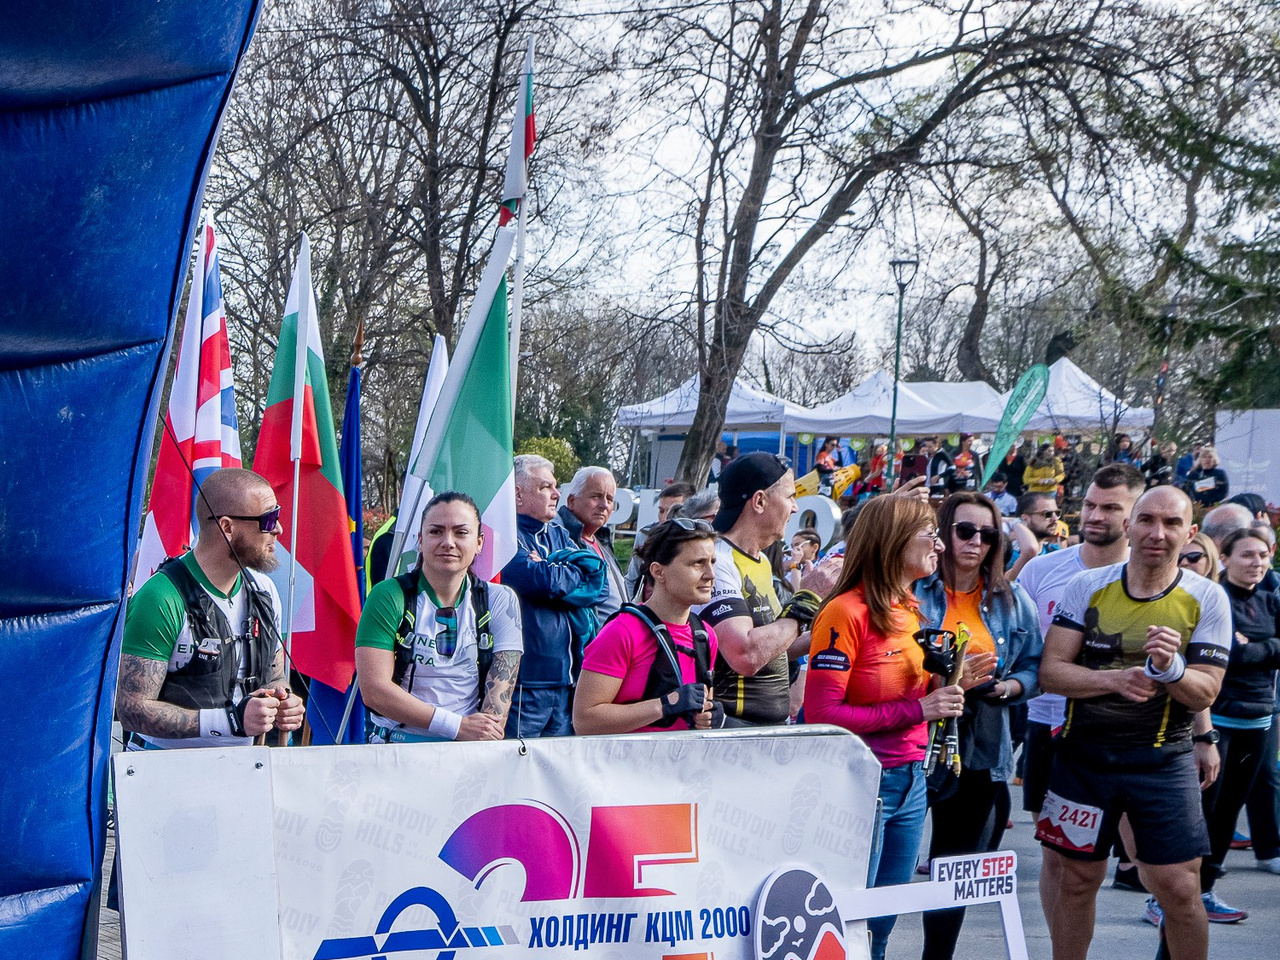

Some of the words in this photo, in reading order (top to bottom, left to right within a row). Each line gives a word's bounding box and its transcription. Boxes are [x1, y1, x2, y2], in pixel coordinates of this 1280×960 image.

[362, 793, 438, 836] PLOVDIV
[712, 800, 778, 841] PLOVDIV
[1059, 804, 1099, 830] 2421
[355, 820, 407, 855] HILLS
[706, 823, 748, 858] HILLS
[938, 859, 981, 882] EVERY
[982, 856, 1014, 877] STEP
[954, 875, 1014, 900] MATTERS
[529, 912, 638, 951] ХОЛДИНГ
[645, 909, 694, 948] КЦМ
[700, 905, 751, 940] 2000
